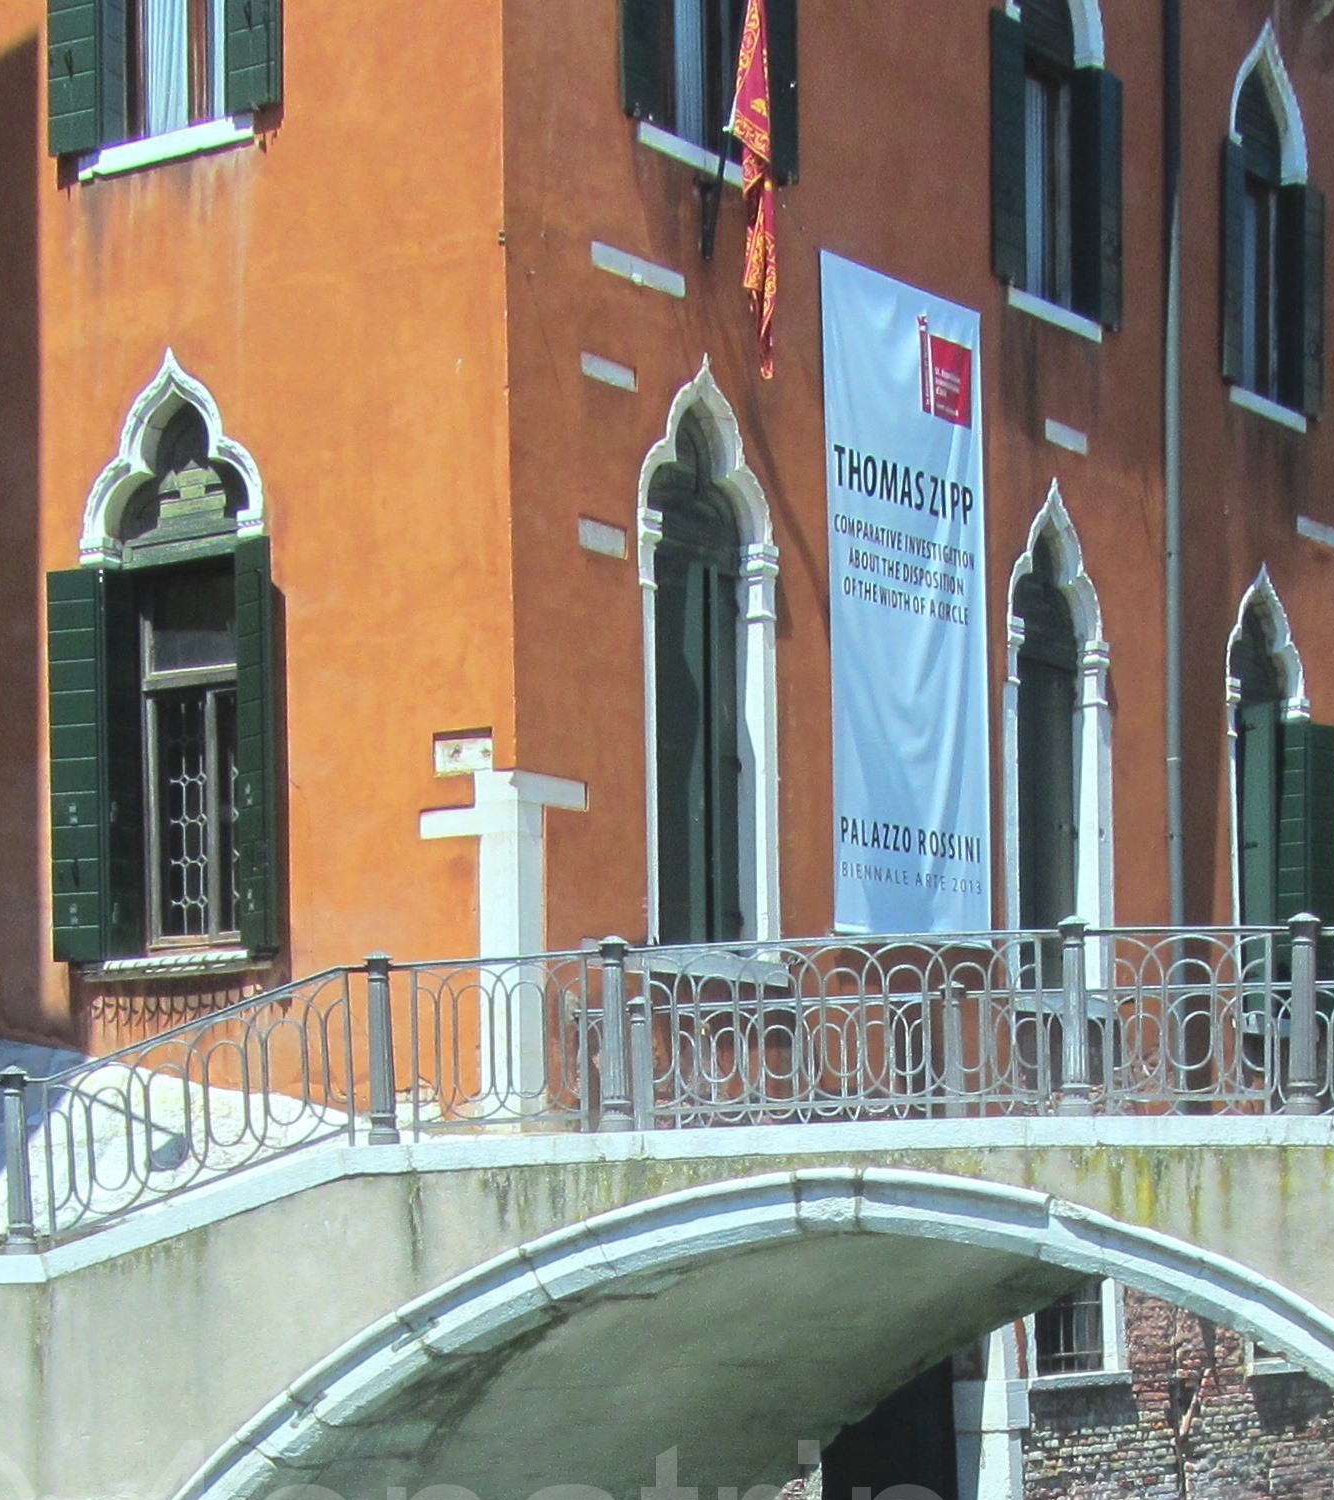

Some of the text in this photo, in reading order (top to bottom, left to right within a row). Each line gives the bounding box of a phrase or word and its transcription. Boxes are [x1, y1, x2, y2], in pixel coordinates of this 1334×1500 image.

[834, 444, 973, 525] THOMAS ZIPP
[834, 514, 975, 570] COMPARATIVE INVESTIGATION
[849, 547, 965, 596] ABOUT THE DISPOSITION
[843, 576, 969, 625] OF THE WIDTH OF A CIRCLE
[841, 817, 981, 864] PALAZZO ROSSINI
[842, 862, 981, 895] BIENNALE ARTE 2013
